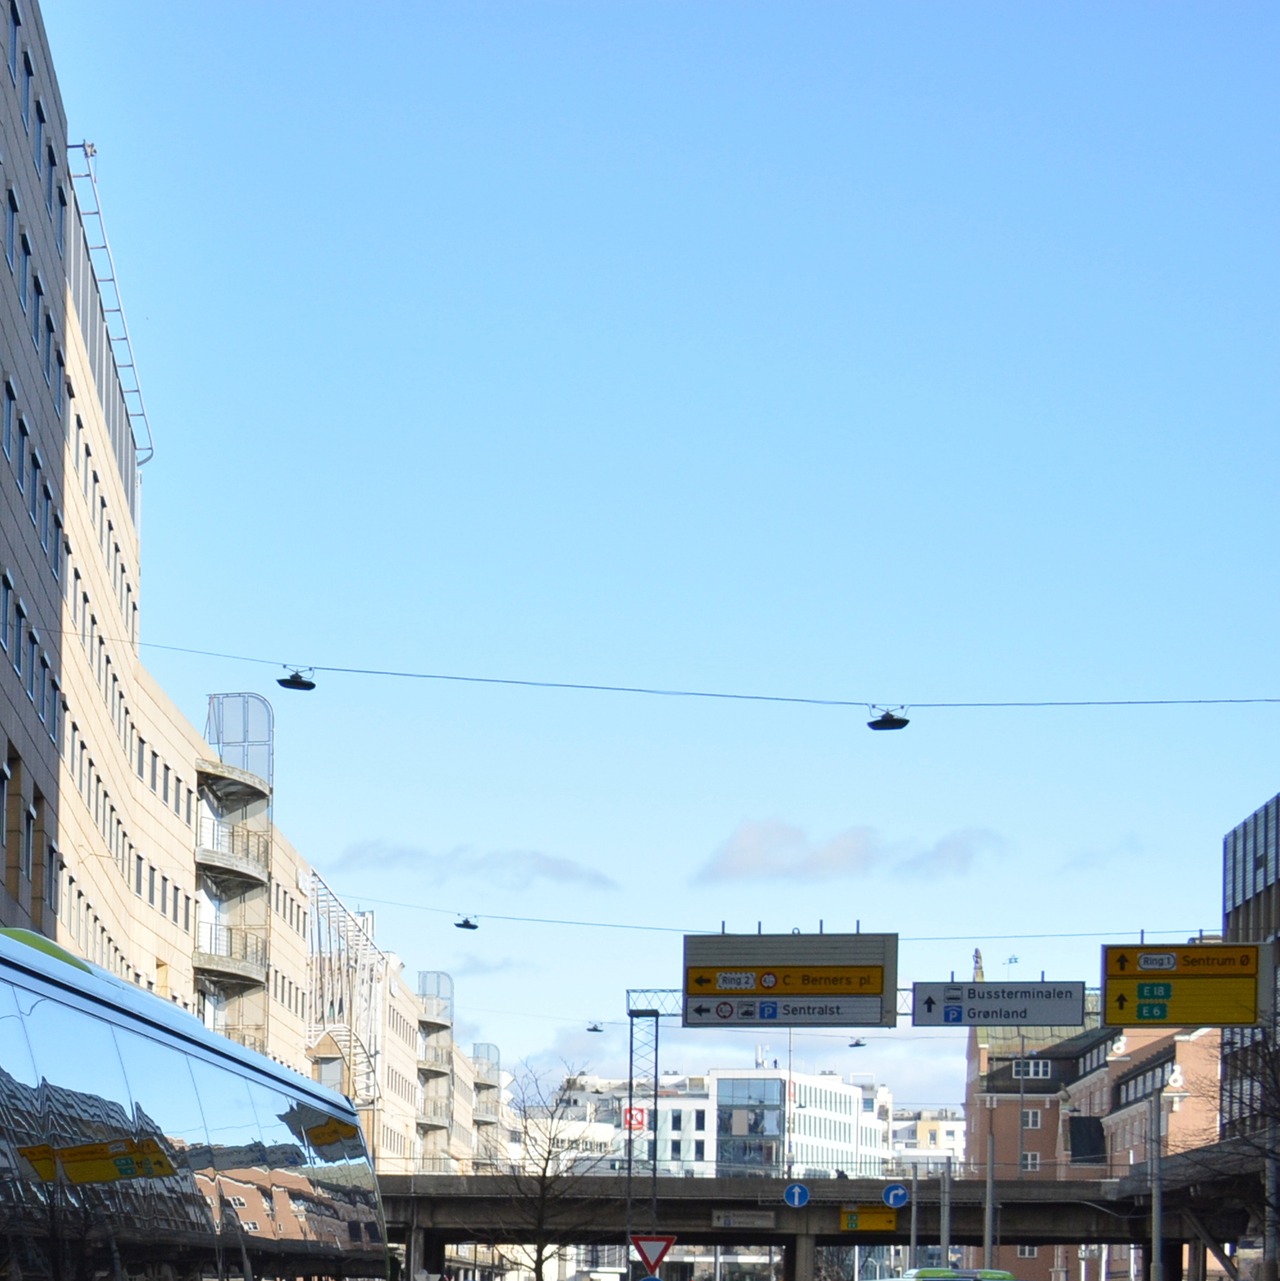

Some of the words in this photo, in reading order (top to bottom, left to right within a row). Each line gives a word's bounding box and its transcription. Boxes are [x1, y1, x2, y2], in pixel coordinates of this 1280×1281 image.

[1143, 957, 1164, 967] Ring
[1166, 957, 1171, 965] 1
[1182, 955, 1236, 966] Sentrum
[1240, 954, 1250, 966] Ø
[721, 975, 741, 986] Ring
[744, 975, 750, 985] 2
[801, 974, 852, 985] Berners
[967, 988, 1073, 1000] Bussterminalen
[1143, 986, 1150, 996] E
[1153, 986, 1165, 996] 18
[967, 1008, 1028, 1019] Grønland
[1142, 1007, 1149, 1017] E
[1152, 1007, 1161, 1017] 6
